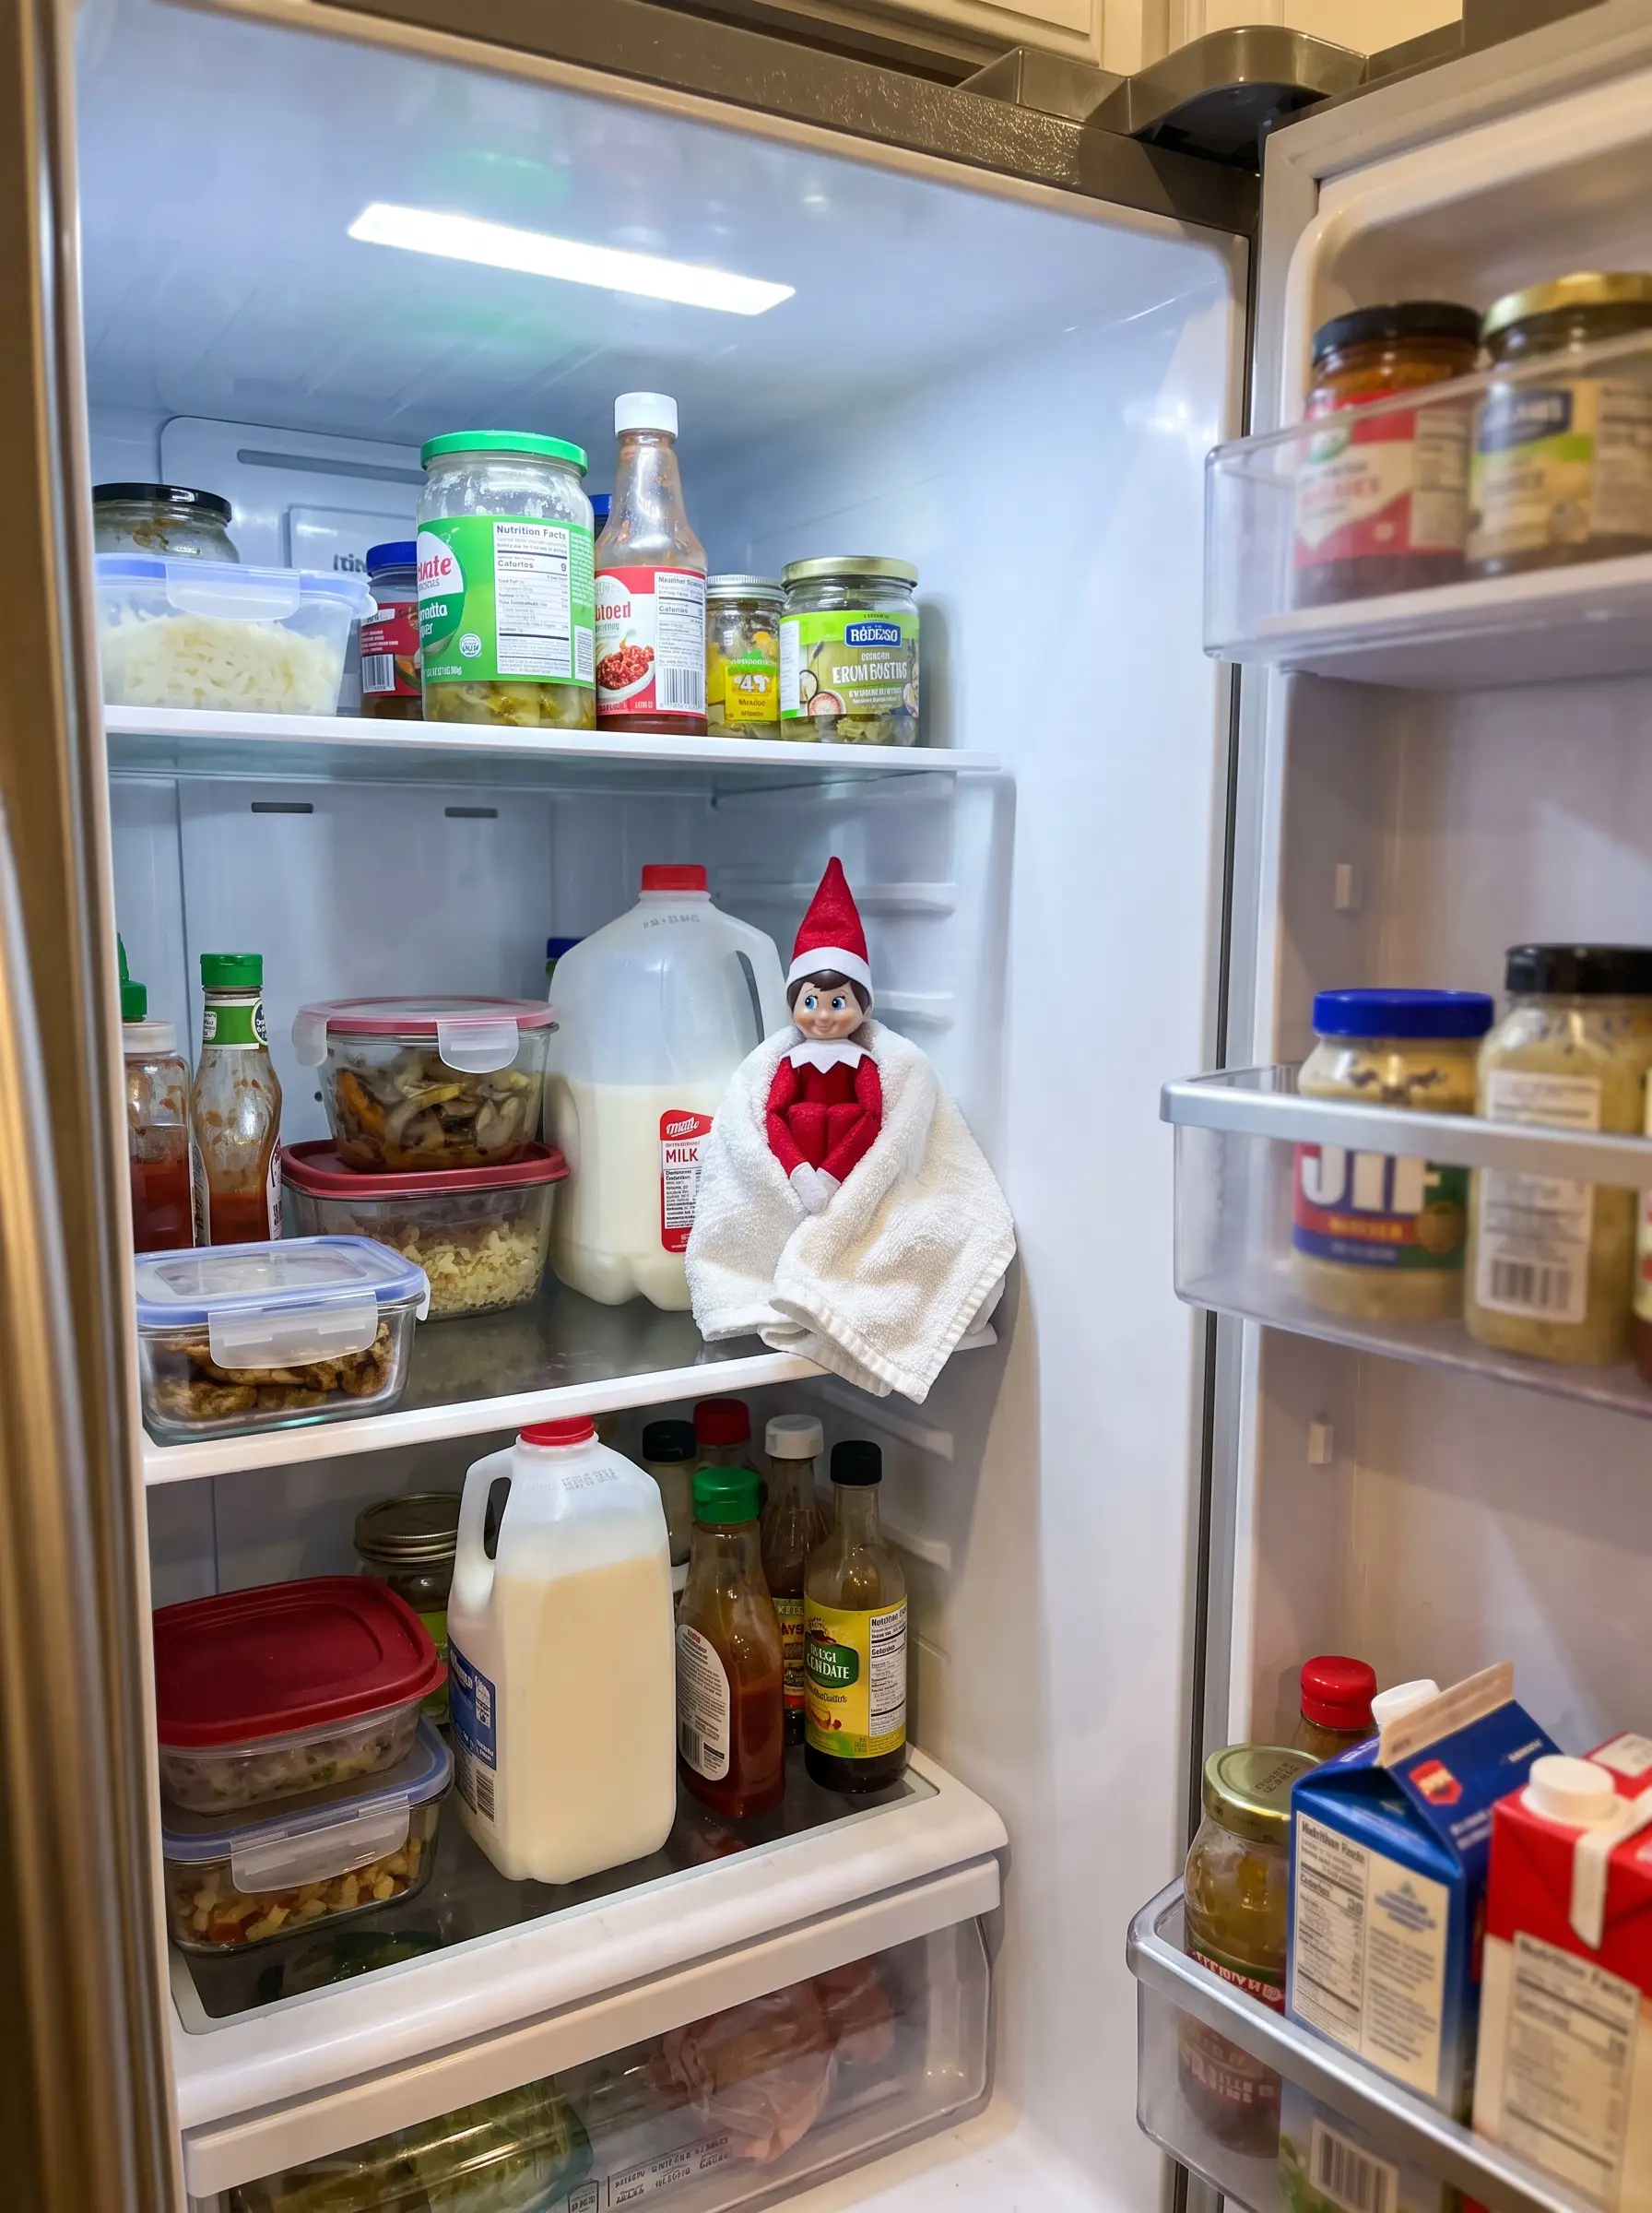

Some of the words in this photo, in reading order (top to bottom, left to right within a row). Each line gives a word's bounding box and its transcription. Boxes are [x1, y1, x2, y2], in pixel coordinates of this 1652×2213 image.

[497, 525, 540, 537] Nutrition
[543, 528, 566, 540] Facts
[666, 1147, 699, 1164] MILK
